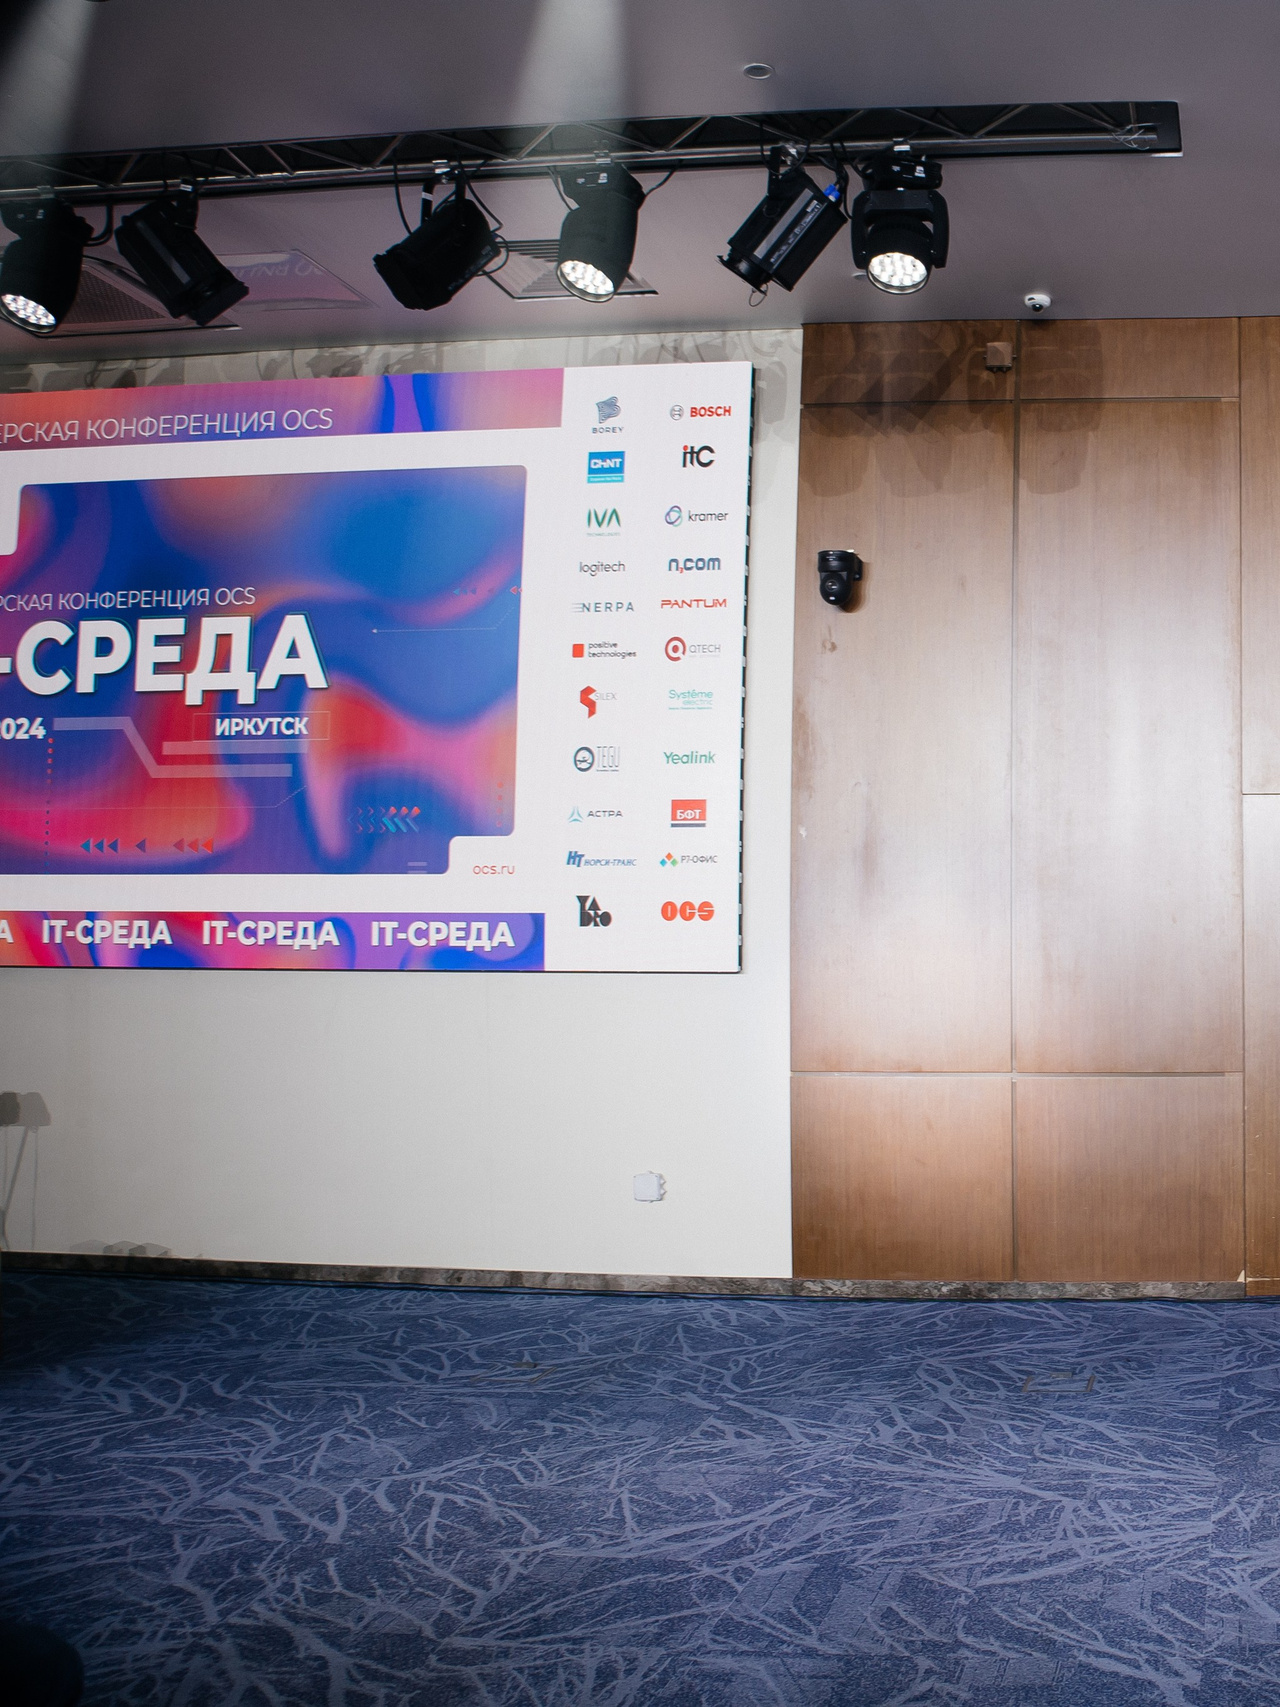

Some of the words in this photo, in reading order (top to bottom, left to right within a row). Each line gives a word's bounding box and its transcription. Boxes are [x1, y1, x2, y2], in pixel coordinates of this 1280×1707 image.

[690, 405, 732, 418] BOSCH
[0, 420, 79, 444] РСКАЯ
[86, 411, 276, 440] КОНФЕРЕНЦИЯ
[591, 426, 625, 434] BOREY
[587, 507, 621, 529] IVA
[688, 510, 729, 522] kramer
[579, 561, 626, 577] logitech
[0, 594, 53, 612] СКАЯ
[59, 589, 210, 610] КОНФЕРЕНЦИЯ
[661, 599, 727, 609] PANTUM
[588, 641, 618, 650] positive
[689, 644, 721, 654] QTECH
[588, 650, 638, 660] technologies
[594, 692, 617, 701] SILEX
[0, 717, 47, 740] 024
[215, 717, 310, 738] ИРКУТСК
[663, 751, 717, 765] Yealink
[676, 809, 702, 821] БФТ
[680, 855, 718, 864] Р7-ОФИС
[472, 862, 516, 876] ocs.ru
[42, 919, 173, 950] IT-СРЕДА
[202, 919, 341, 951] IT-СРЕДА
[371, 920, 516, 953] IT-СРЕДА
